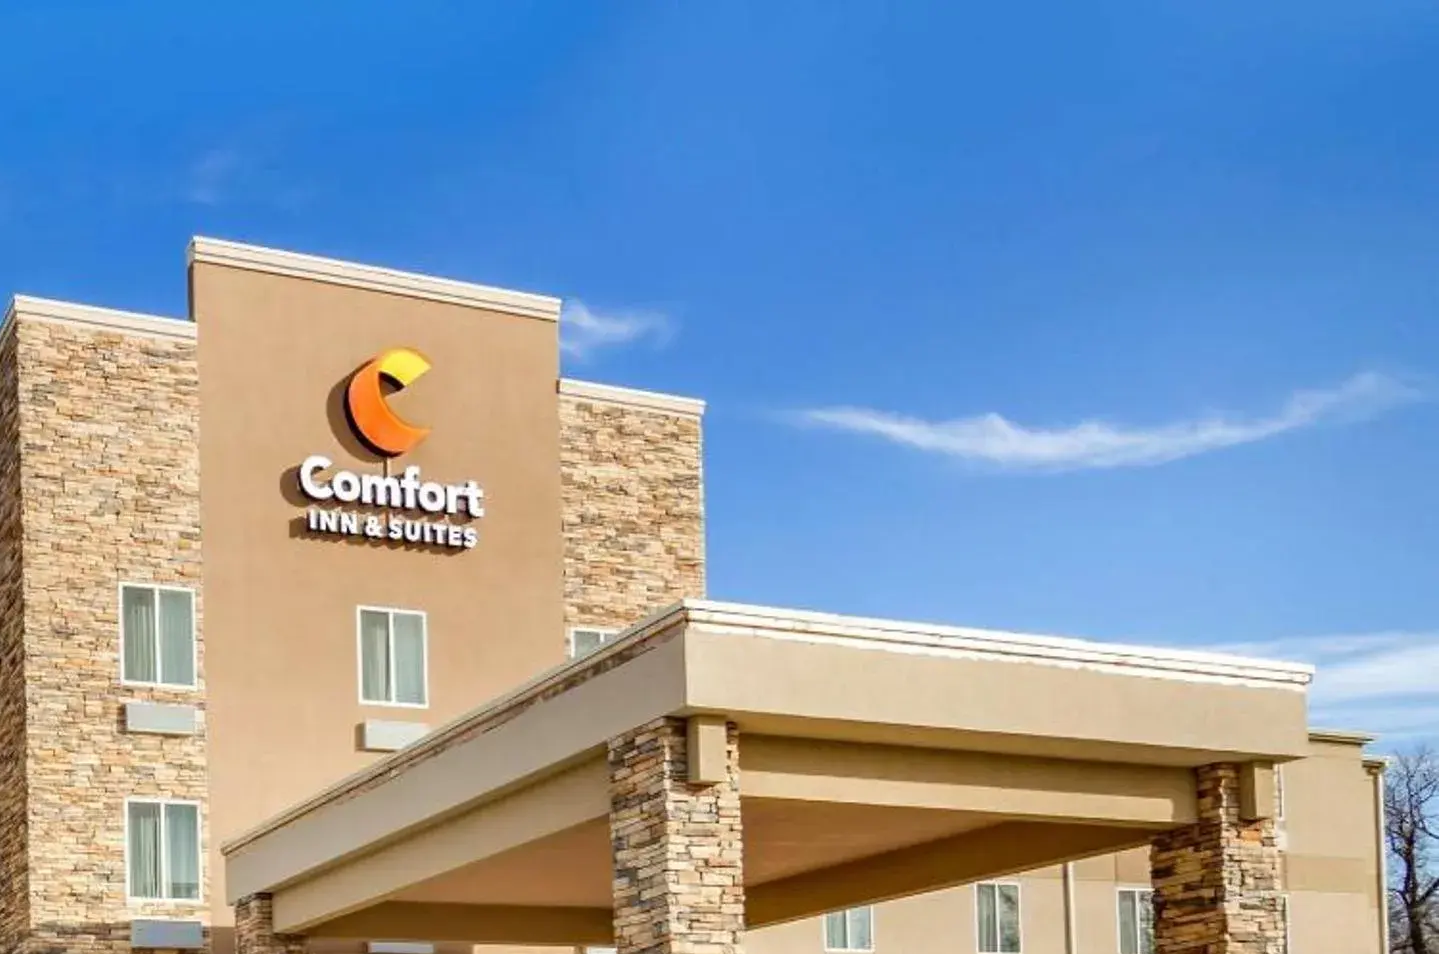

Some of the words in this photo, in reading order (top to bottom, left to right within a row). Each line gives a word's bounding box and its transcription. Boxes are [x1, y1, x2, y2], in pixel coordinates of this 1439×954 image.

[299, 455, 485, 518] Comfort
[308, 508, 359, 535] INN
[364, 516, 384, 538] &
[388, 519, 479, 548] SUITES
